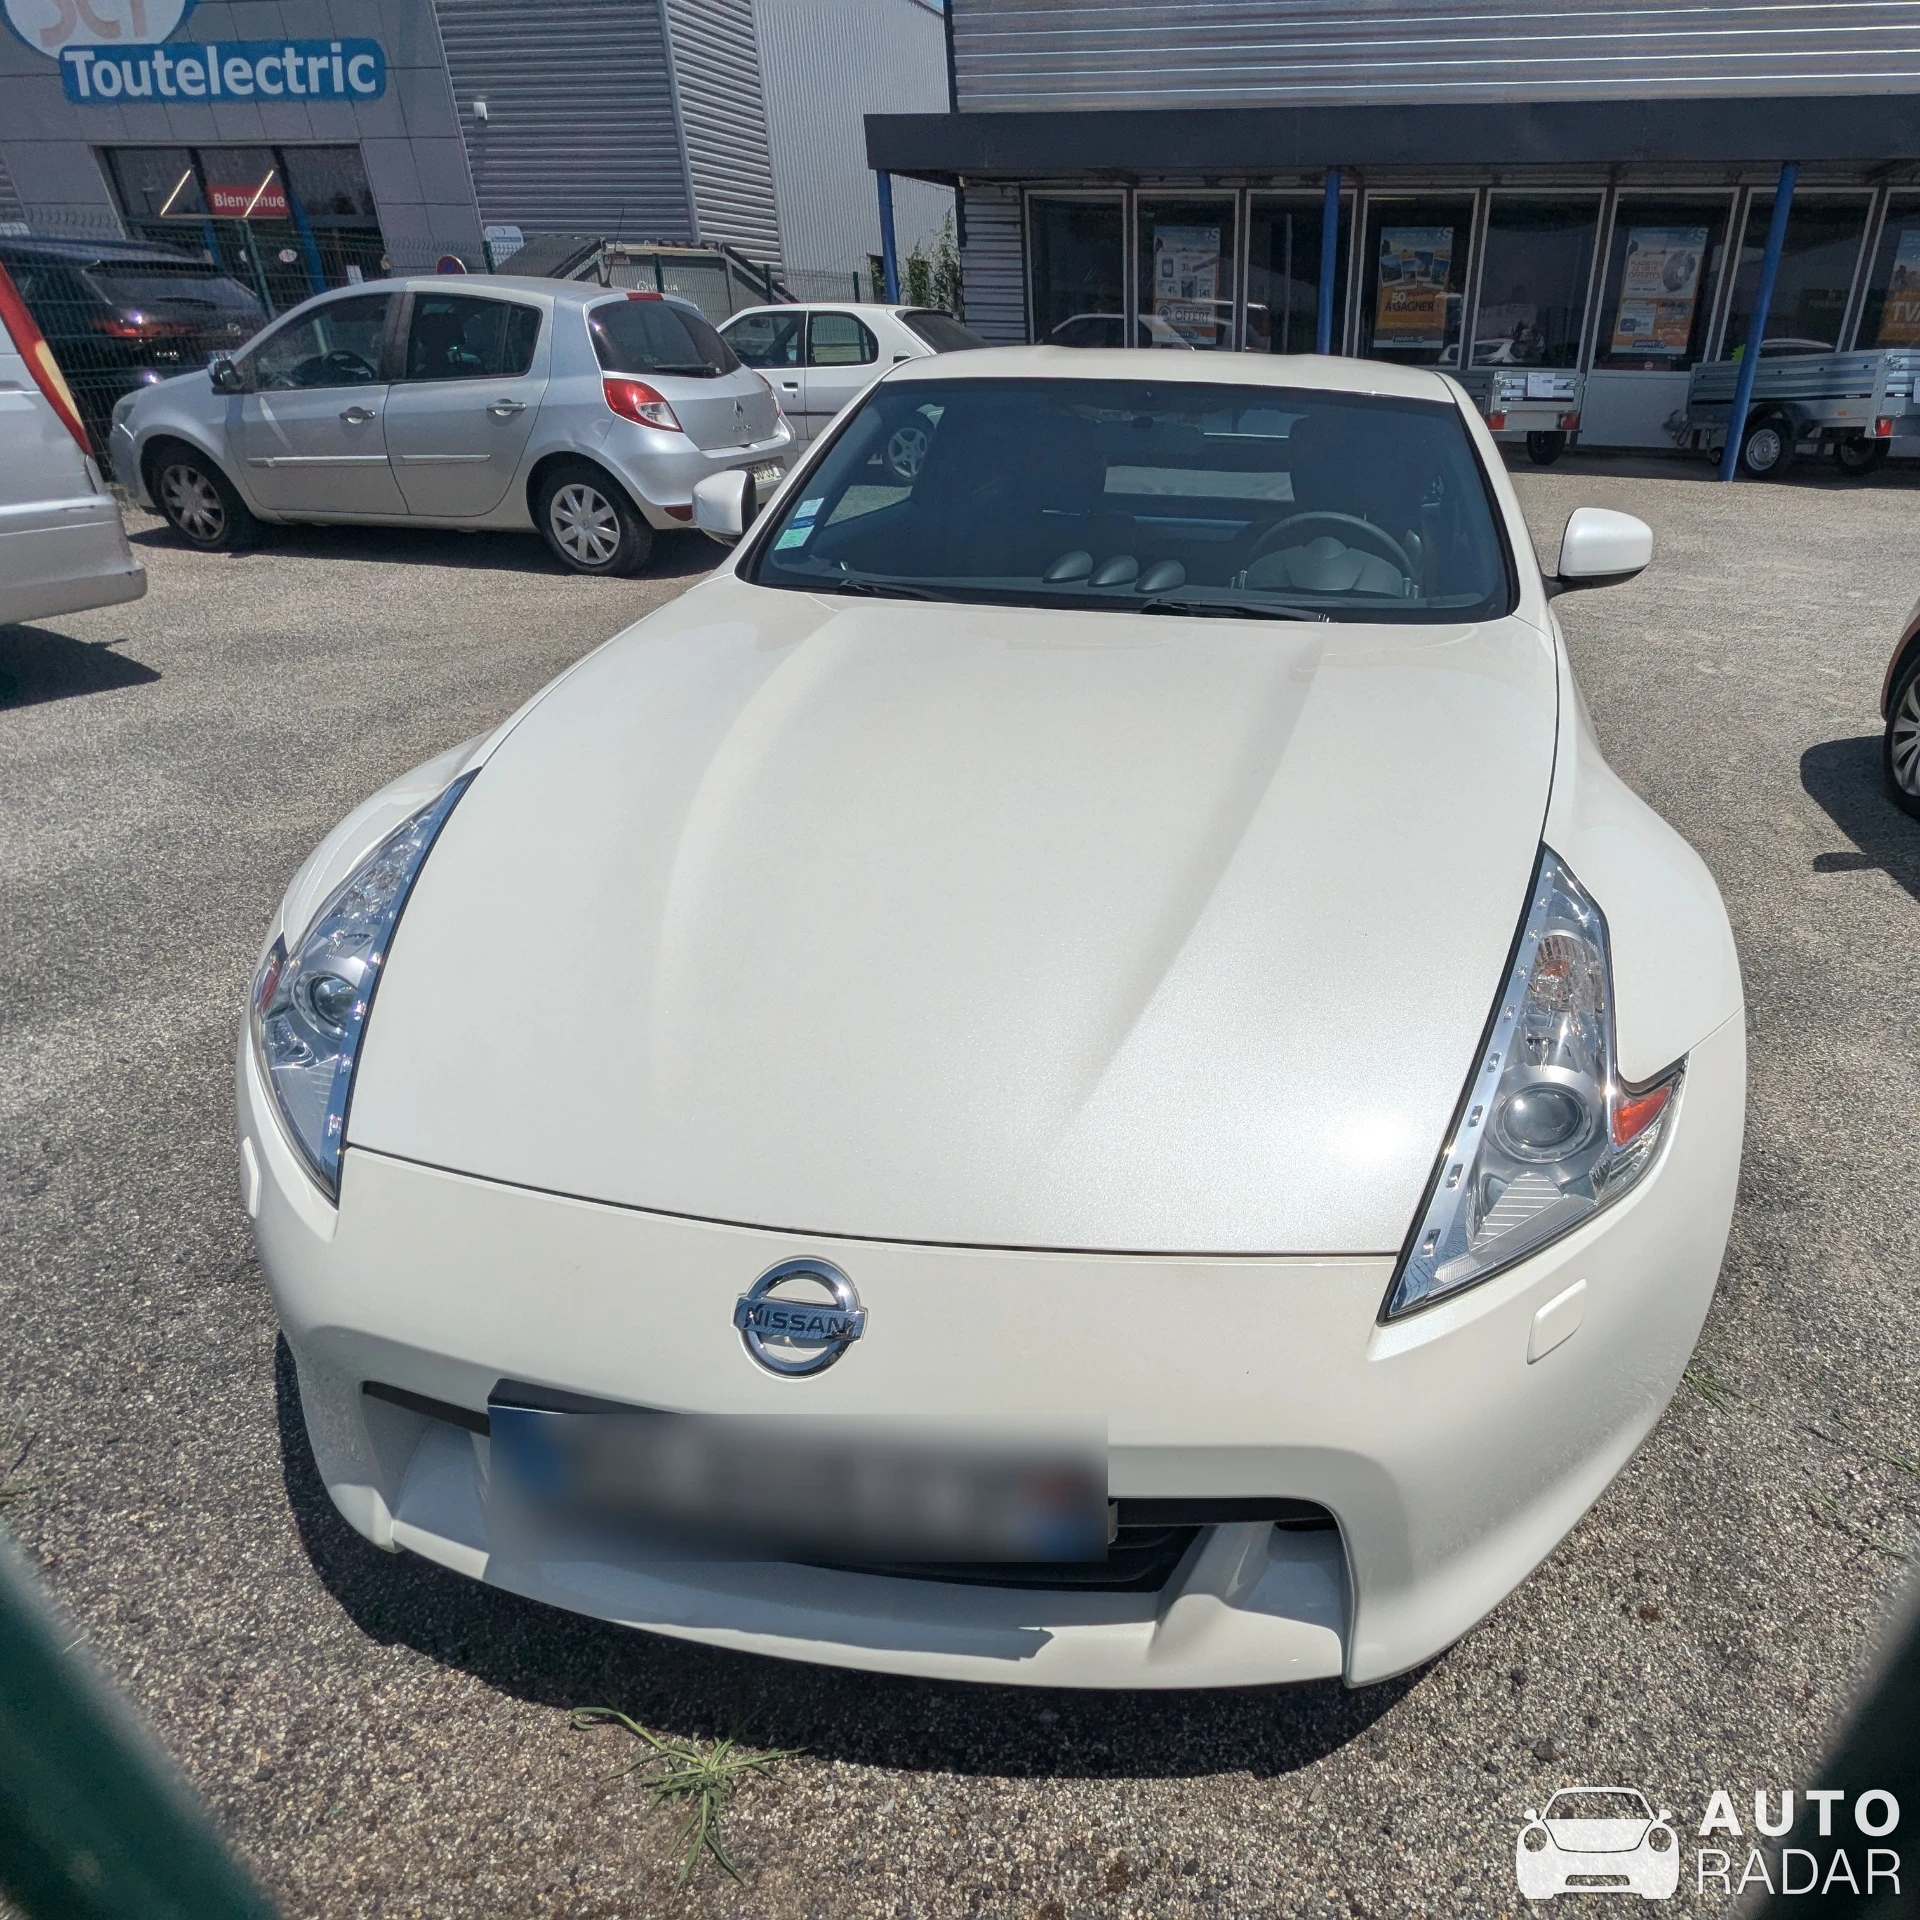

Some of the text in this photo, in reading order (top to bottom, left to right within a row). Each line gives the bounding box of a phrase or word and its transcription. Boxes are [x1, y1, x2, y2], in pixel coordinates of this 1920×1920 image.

[64, 42, 376, 97] Toutelectric
[214, 192, 286, 208] Bienvenue
[1391, 291, 1406, 304] 50
[1393, 301, 1434, 311] GAGNER
[1176, 310, 1210, 321] OFFERT
[745, 1306, 852, 1336] NISSAN
